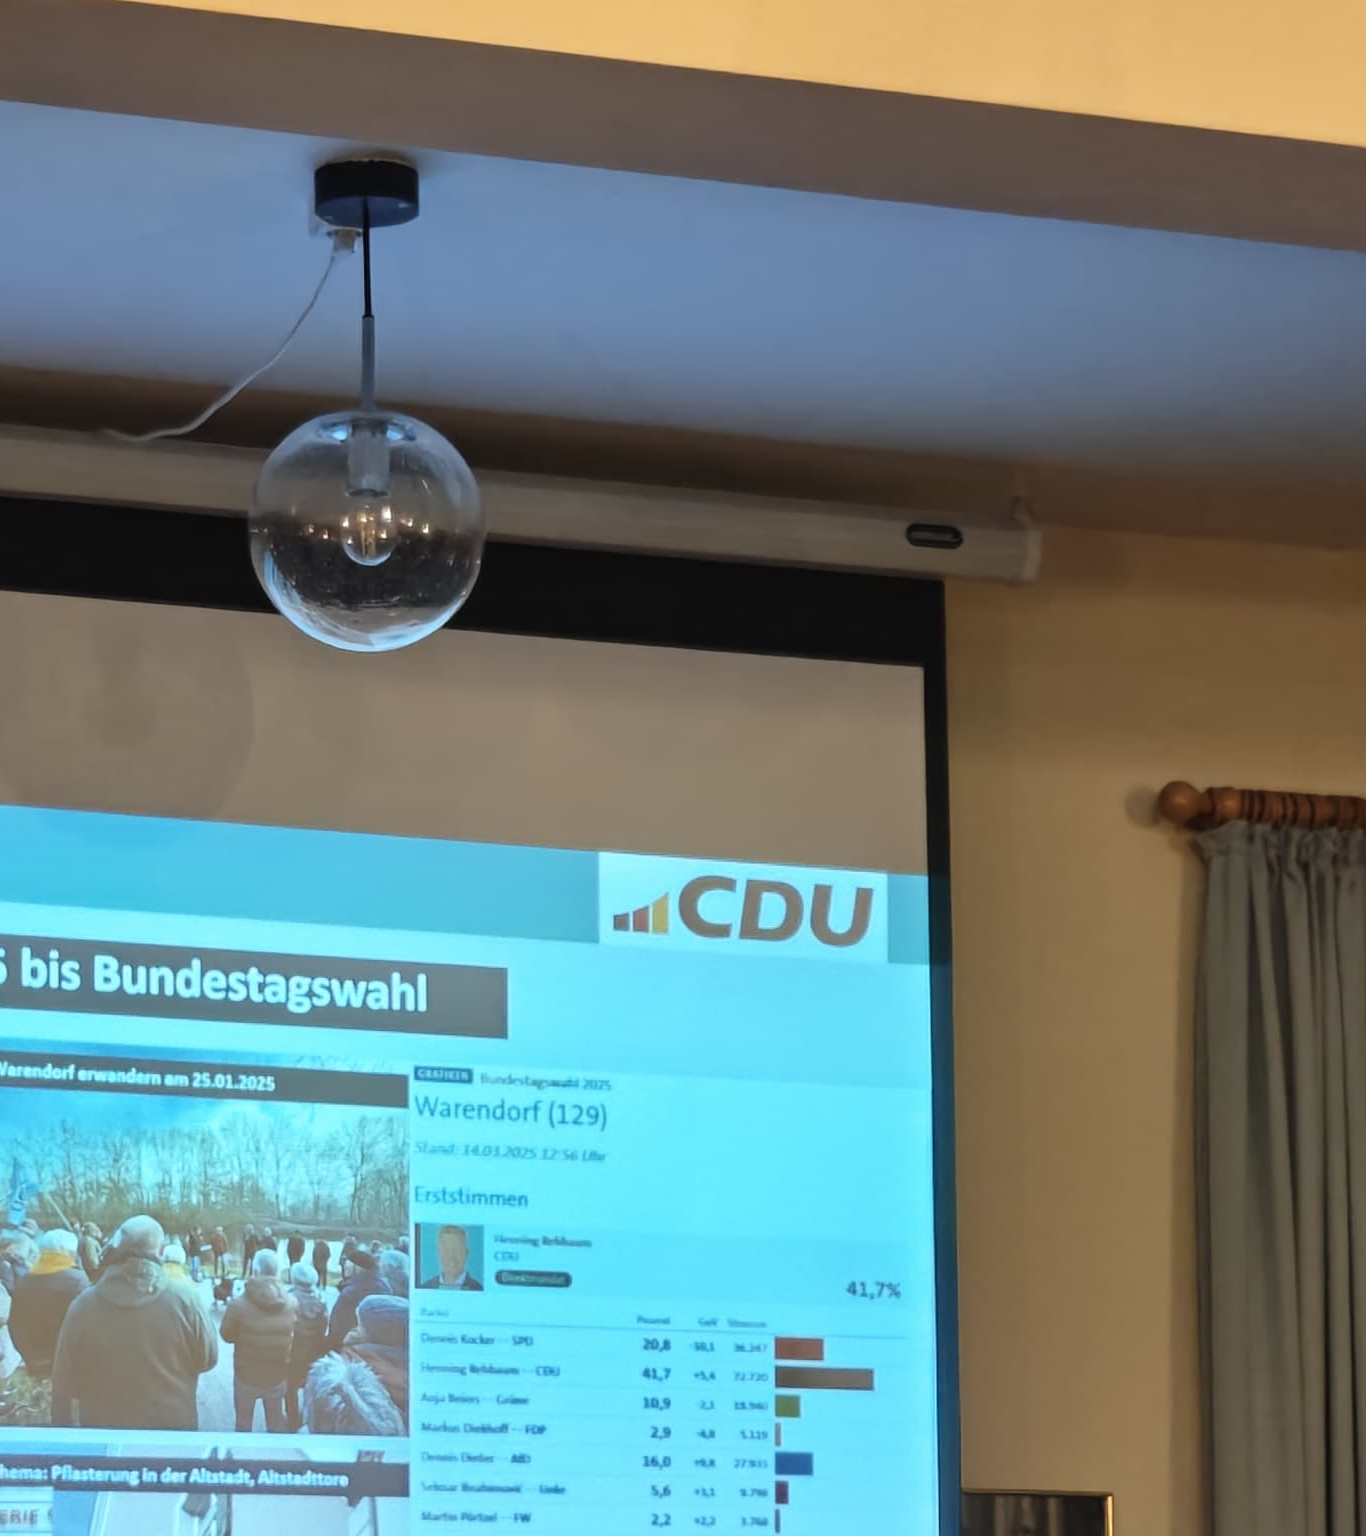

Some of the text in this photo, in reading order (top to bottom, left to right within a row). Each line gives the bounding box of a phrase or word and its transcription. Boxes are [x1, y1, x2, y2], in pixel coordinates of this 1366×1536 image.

[678, 875, 874, 948] CDU
[20, 946, 81, 992] bis
[93, 953, 429, 1015] Bundestagswahl
[77, 1067, 162, 1087] erwandern
[164, 1074, 190, 1088] am
[192, 1072, 277, 1093] 25.01.2025
[583, 1077, 612, 1092] 2025
[414, 1094, 608, 1132] Warendorf (129)
[581, 1149, 607, 1163] Uhr
[414, 1184, 530, 1208] Erststimmen
[845, 1280, 902, 1300] 41,7%
[511, 1336, 535, 1347] SPD
[641, 1337, 672, 1353] 20,8
[641, 1367, 672, 1382] 41,7
[641, 1396, 672, 1412] 10,9
[525, 1424, 548, 1436] FDP
[650, 1425, 672, 1440] 2,9
[642, 1454, 672, 1470] 16,0
[51, 1465, 140, 1487] Pflasterung
[142, 1467, 157, 1482] in
[160, 1468, 188, 1484] der
[188, 1468, 256, 1488] Altstadt,
[650, 1484, 672, 1499] 5,6
[513, 1512, 532, 1524] FW
[650, 1513, 672, 1527] 2,2
